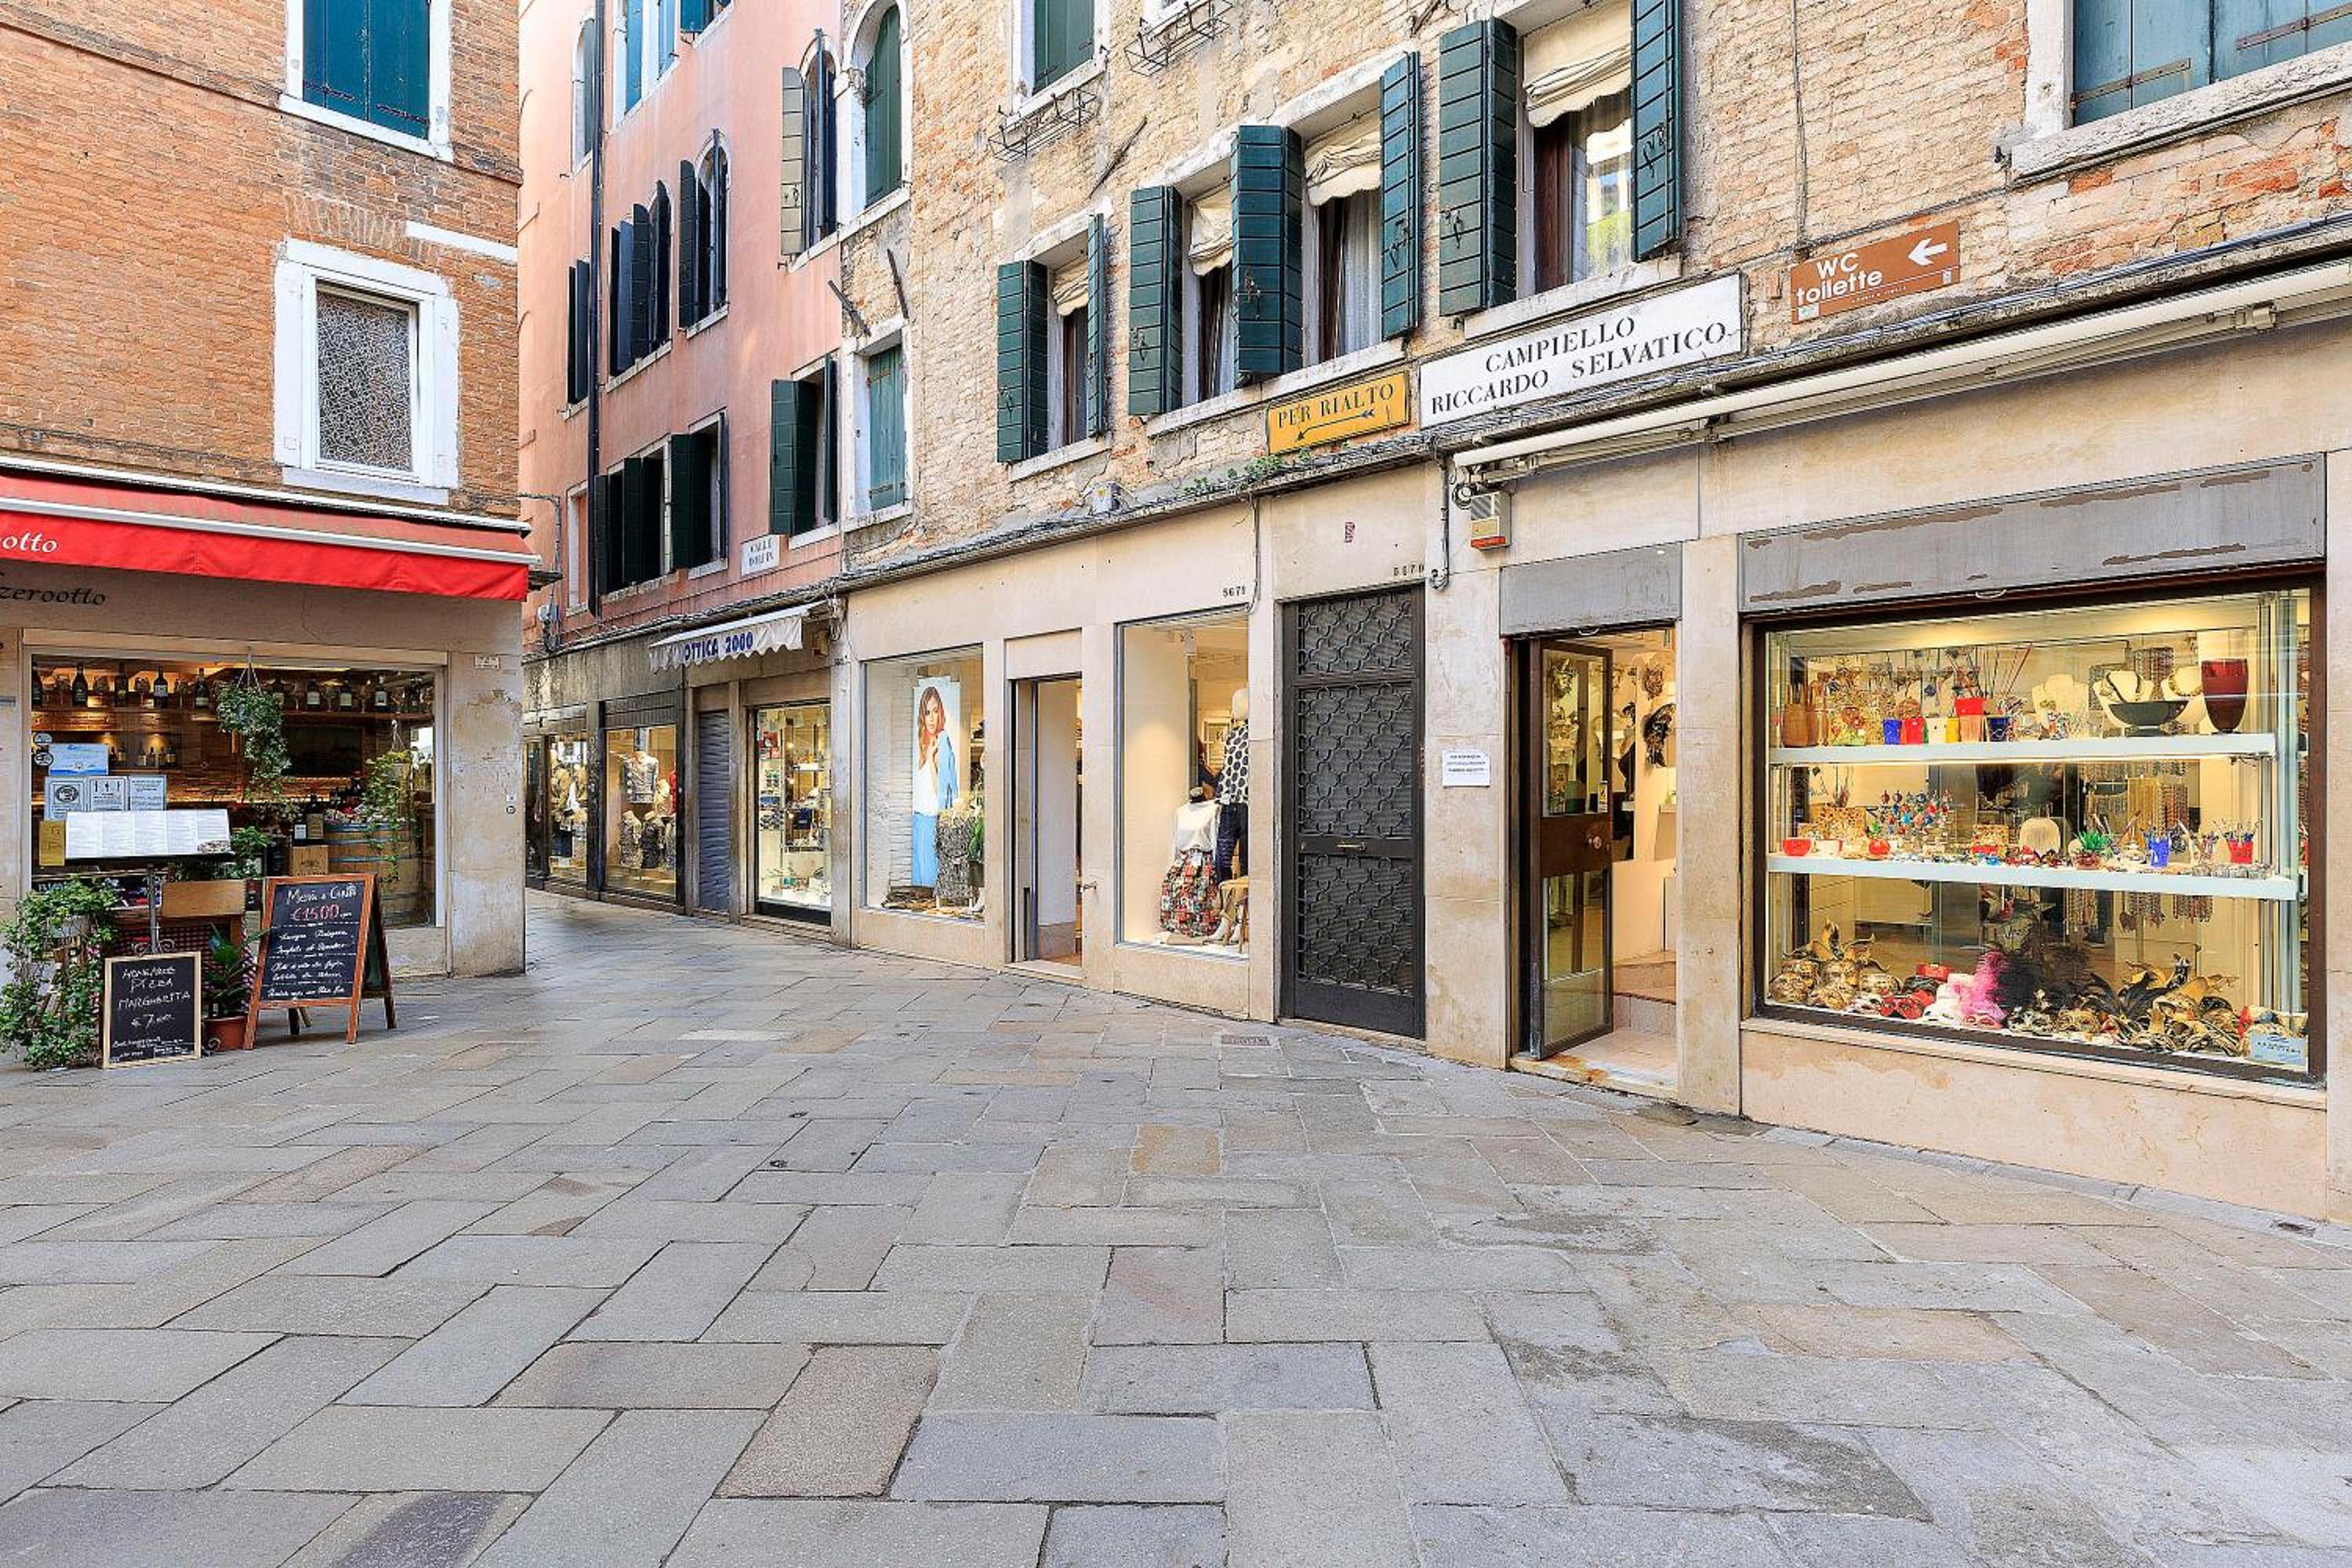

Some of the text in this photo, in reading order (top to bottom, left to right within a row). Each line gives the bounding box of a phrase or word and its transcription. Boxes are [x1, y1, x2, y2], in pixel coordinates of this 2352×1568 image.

[1817, 252, 1859, 279] WC
[1796, 270, 1882, 306] toilette
[1486, 316, 1635, 374] CAMPIELLO
[1432, 321, 1726, 415] RICCARDO SELVATICO
[1278, 383, 1394, 428] PER RIALTO
[0, 532, 58, 553] otto
[684, 631, 754, 662] OTTICA 2000
